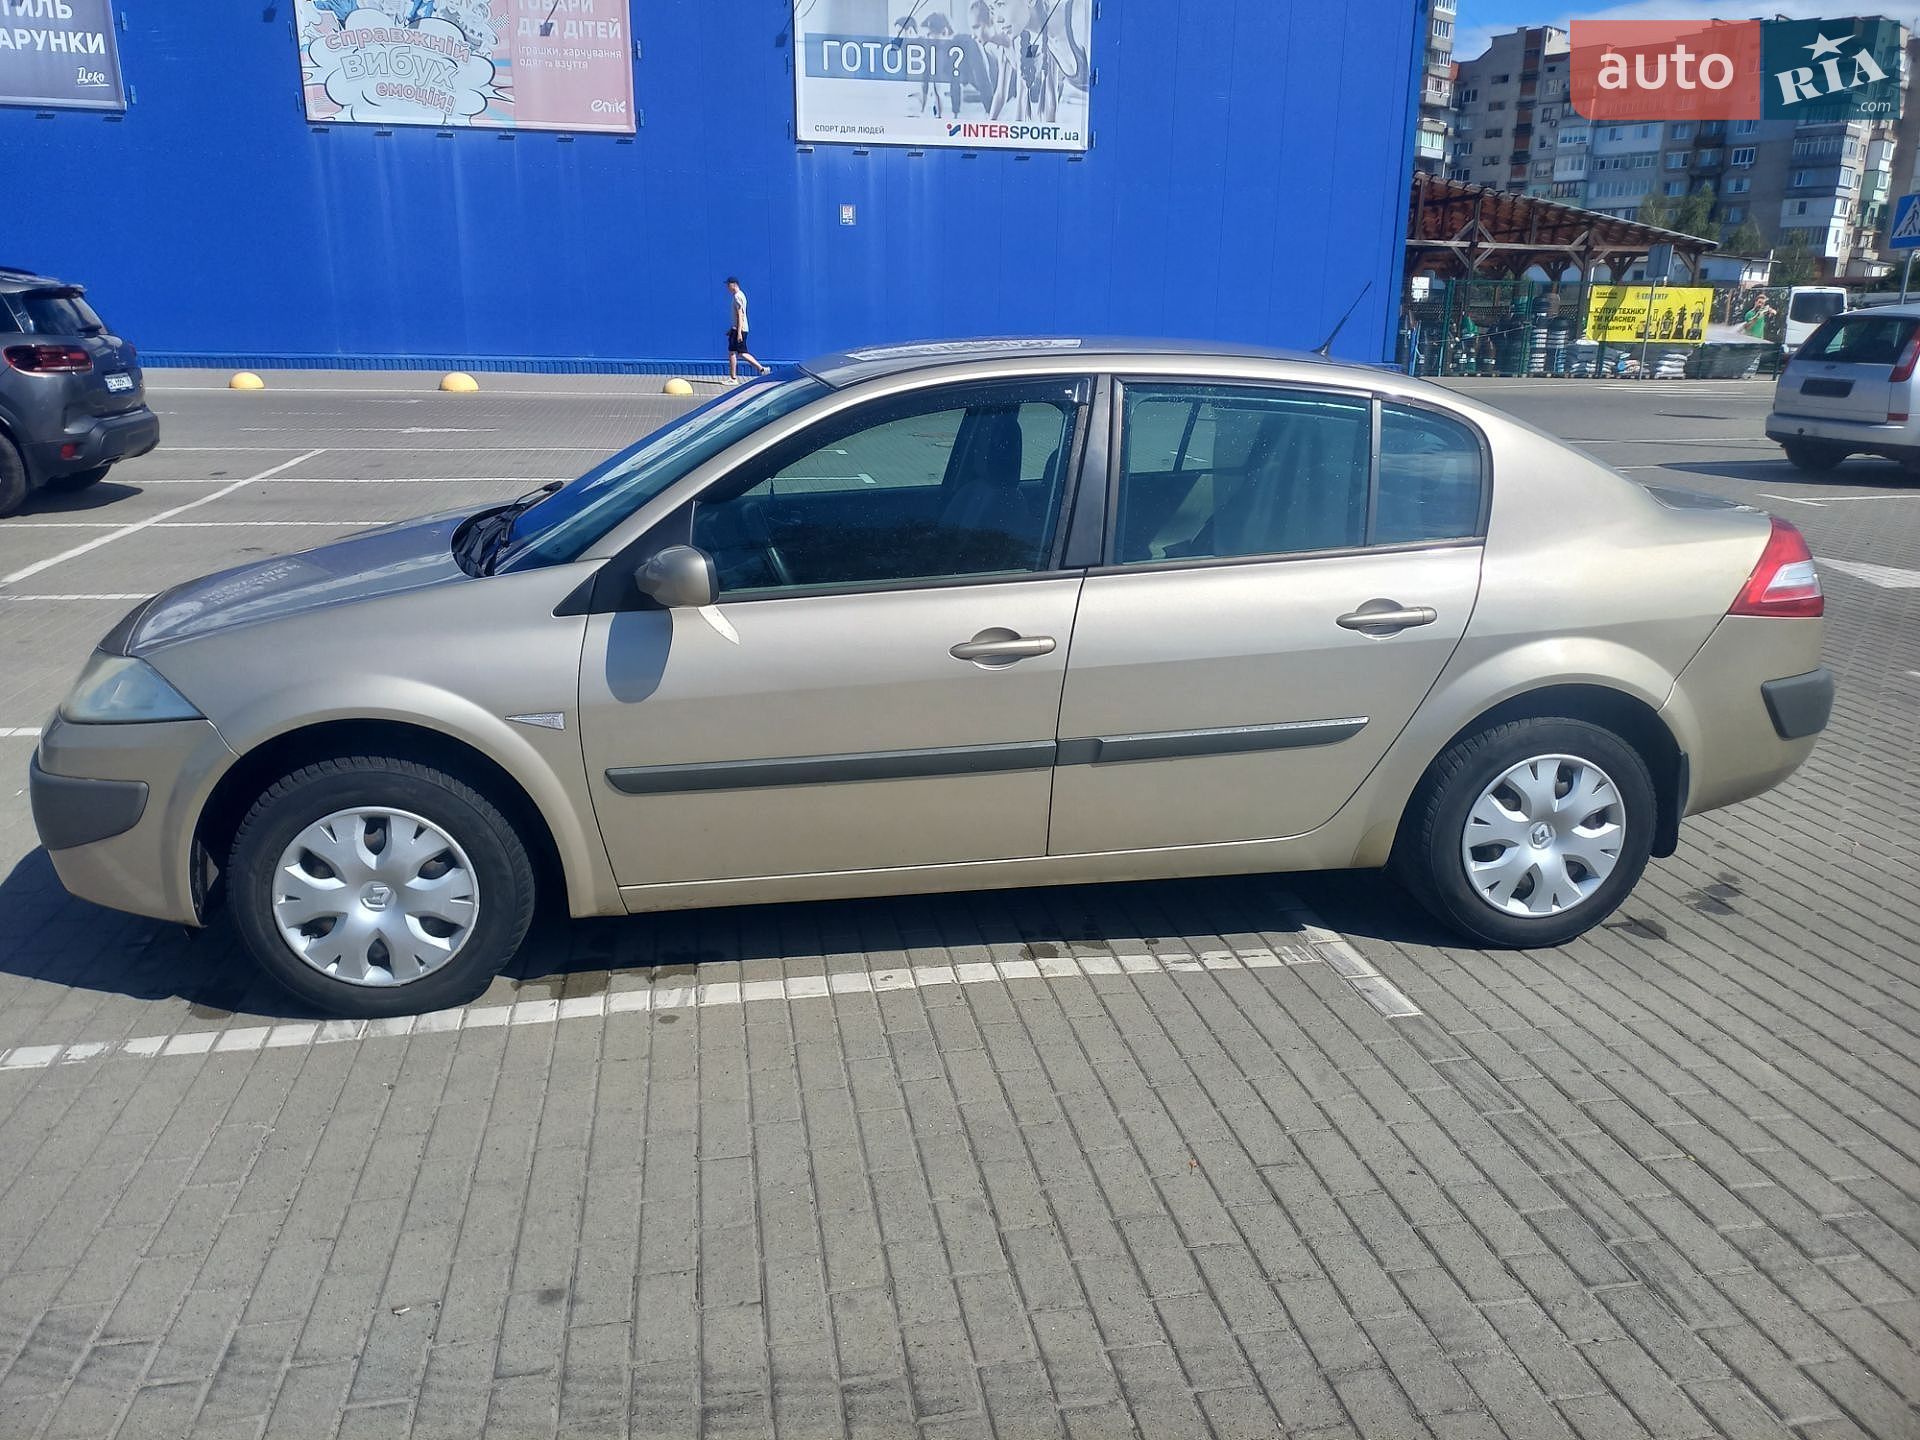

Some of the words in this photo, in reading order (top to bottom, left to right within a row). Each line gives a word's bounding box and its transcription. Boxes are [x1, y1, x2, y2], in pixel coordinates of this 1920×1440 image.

[563, 17, 621, 40] ДІТЕЙ
[325, 27, 471, 63] справжній
[563, 46, 622, 60] харчування
[340, 46, 459, 90] вибух
[822, 40, 937, 76] ГОТОВІ
[948, 46, 965, 77] ?
[375, 81, 456, 116] емоцій!
[814, 124, 838, 133] СПОРТ
[839, 125, 856, 134] ДЛЯ
[857, 125, 885, 135] ЛЮДЕЙ
[963, 124, 1079, 141] INTERSPORT.ua
[1618, 306, 1647, 315] ТЕХНІКУ
